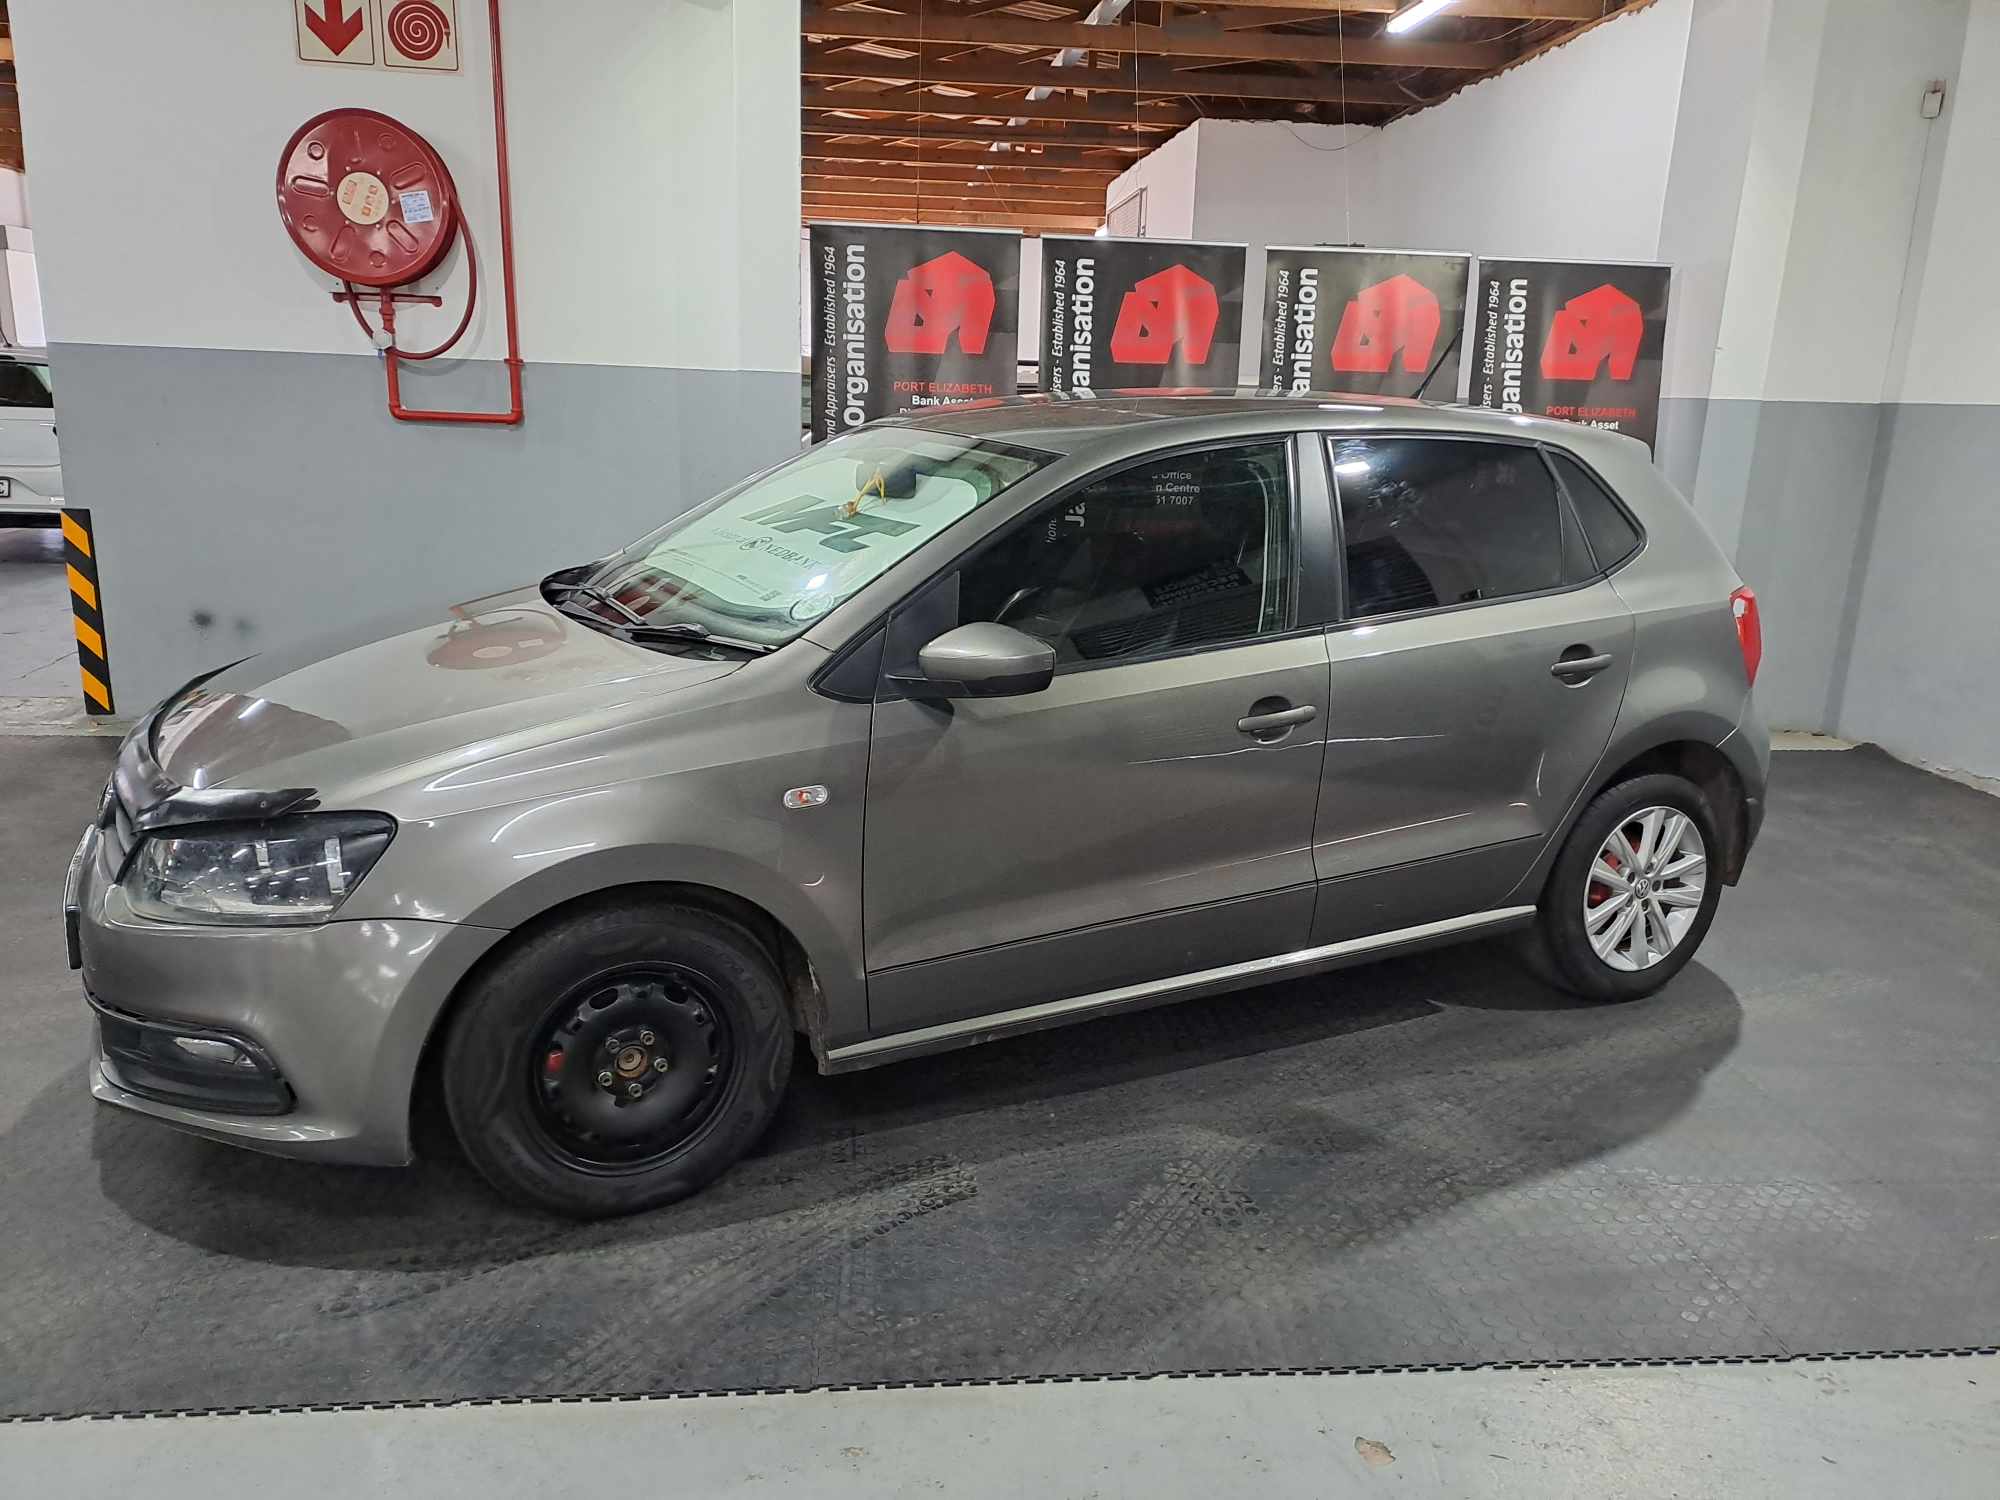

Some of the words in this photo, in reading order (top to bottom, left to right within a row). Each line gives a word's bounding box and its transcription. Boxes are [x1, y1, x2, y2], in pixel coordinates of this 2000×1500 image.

[824, 246, 836, 275] 1964
[1053, 259, 1066, 288] 1964
[1278, 269, 1290, 297] 1964
[1489, 281, 1500, 308] 1964
[823, 278, 836, 346] Established
[1051, 290, 1065, 357] Established
[843, 244, 868, 426] Organisation
[1273, 300, 1288, 366] Established
[1290, 268, 1318, 394] anisation
[1483, 309, 1498, 375] Established
[1501, 279, 1527, 413] ganisation
[824, 356, 838, 418] Appraisers
[893, 381, 926, 393] PORT
[928, 382, 993, 395] ELIZABETH
[911, 395, 940, 406] Bank
[1545, 406, 1577, 416] PORT
[1577, 407, 1636, 417] ELIZABETH
[1165, 482, 1200, 493] Centre
[1169, 495, 1194, 505] 7007
